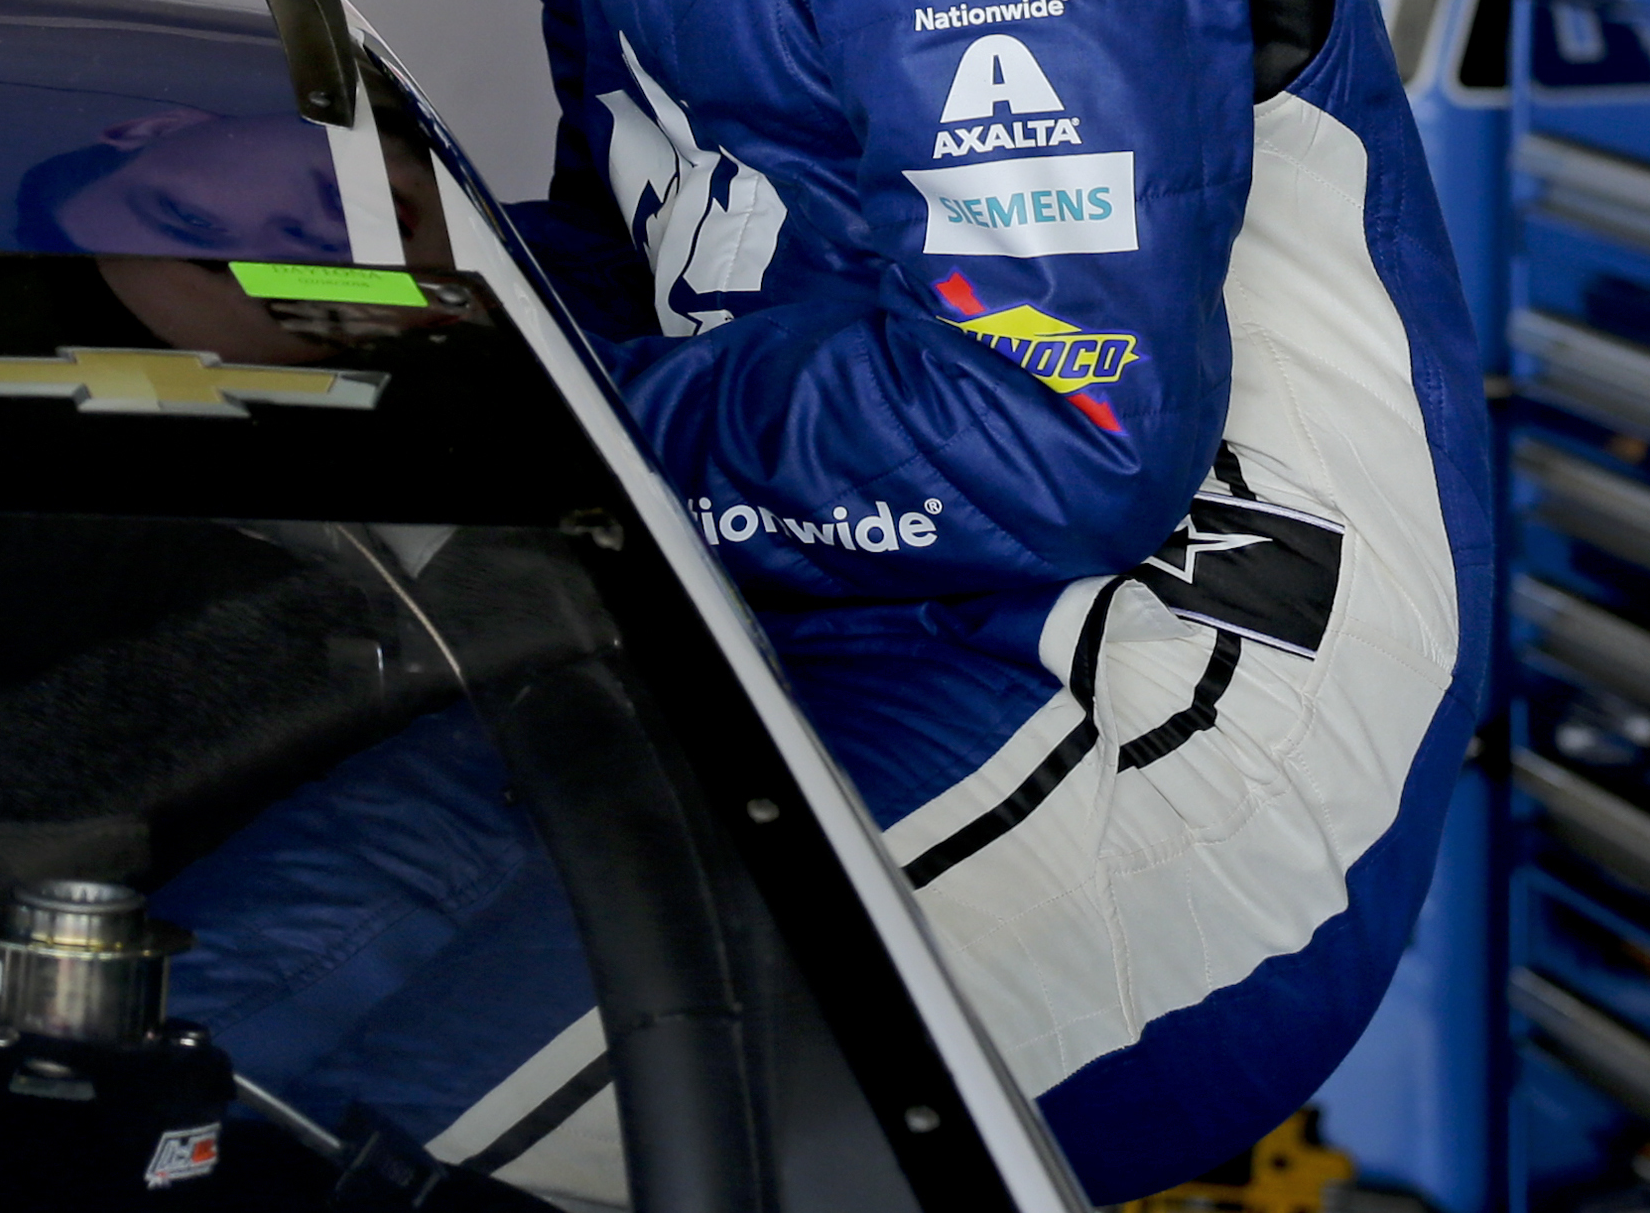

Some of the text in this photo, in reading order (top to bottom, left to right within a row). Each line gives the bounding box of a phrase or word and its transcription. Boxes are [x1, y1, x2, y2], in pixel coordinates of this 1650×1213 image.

[932, 119, 1083, 159] AXALTA
[939, 187, 1113, 229] SIEMENS
[965, 330, 1130, 380] NOCO
